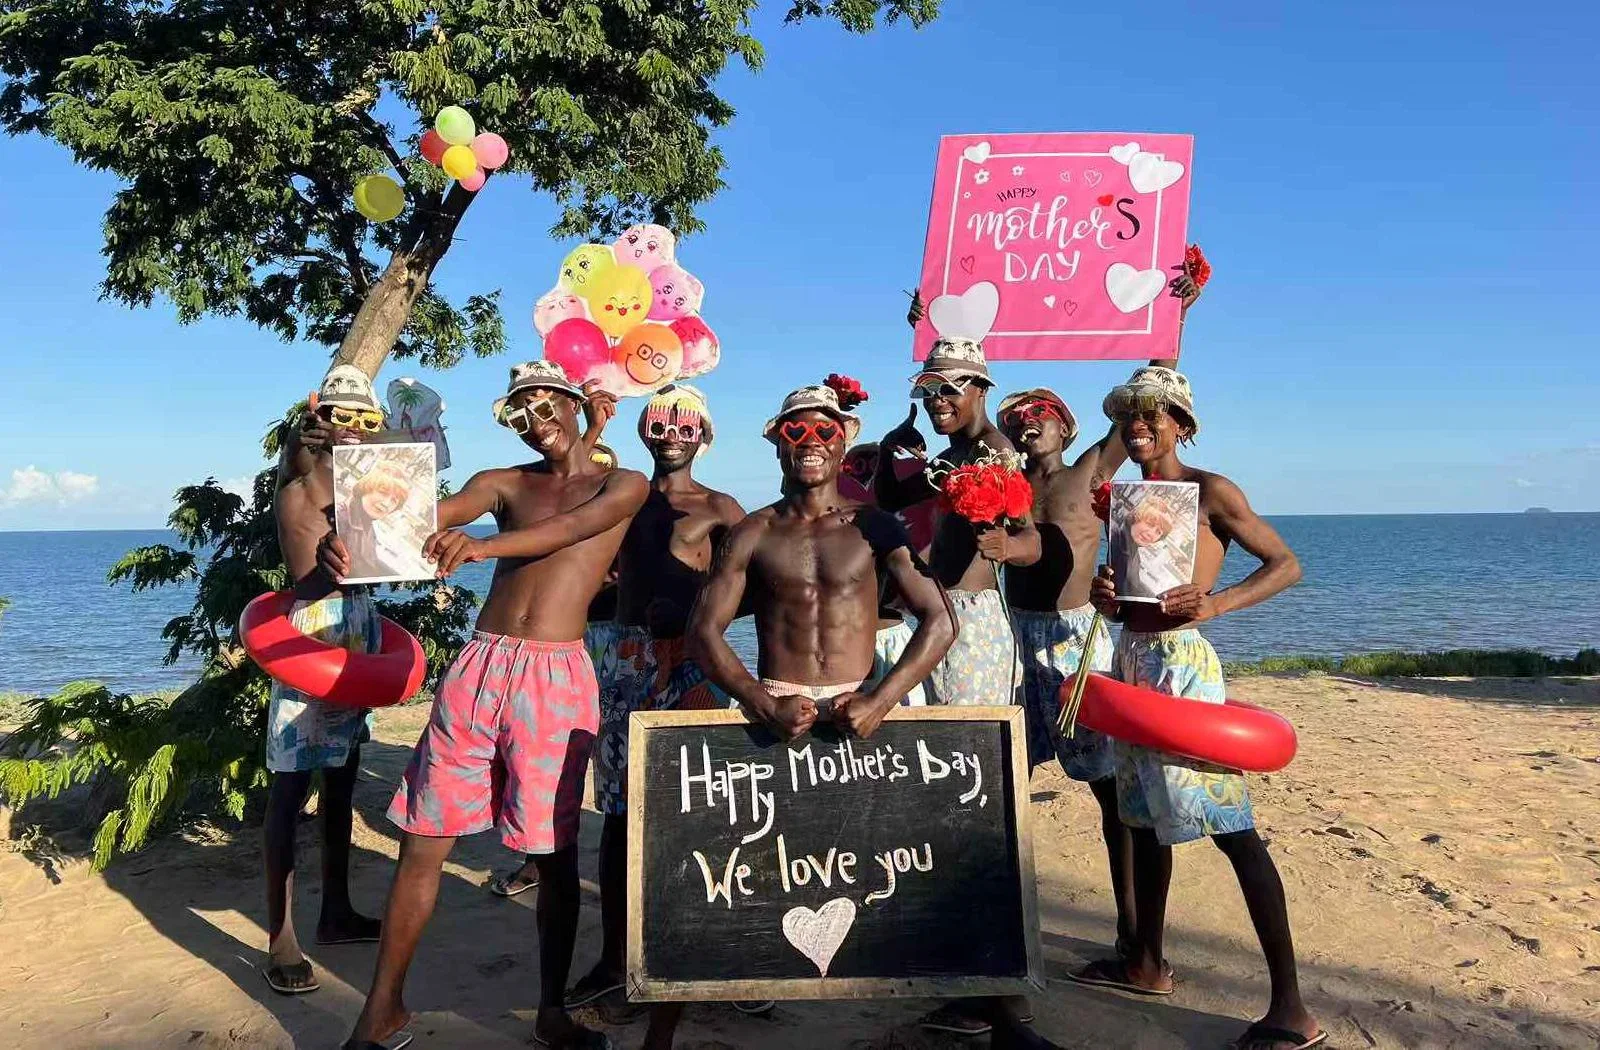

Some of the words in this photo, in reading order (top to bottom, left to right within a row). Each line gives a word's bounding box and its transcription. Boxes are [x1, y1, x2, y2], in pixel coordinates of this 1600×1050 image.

[996, 187, 1038, 203] HAPPY
[1003, 250, 1081, 282] DAY
[680, 739, 775, 844] Happy
[788, 739, 909, 793] Mother's
[693, 847, 754, 908] We
[777, 833, 857, 893] love
[864, 843, 934, 905] you
